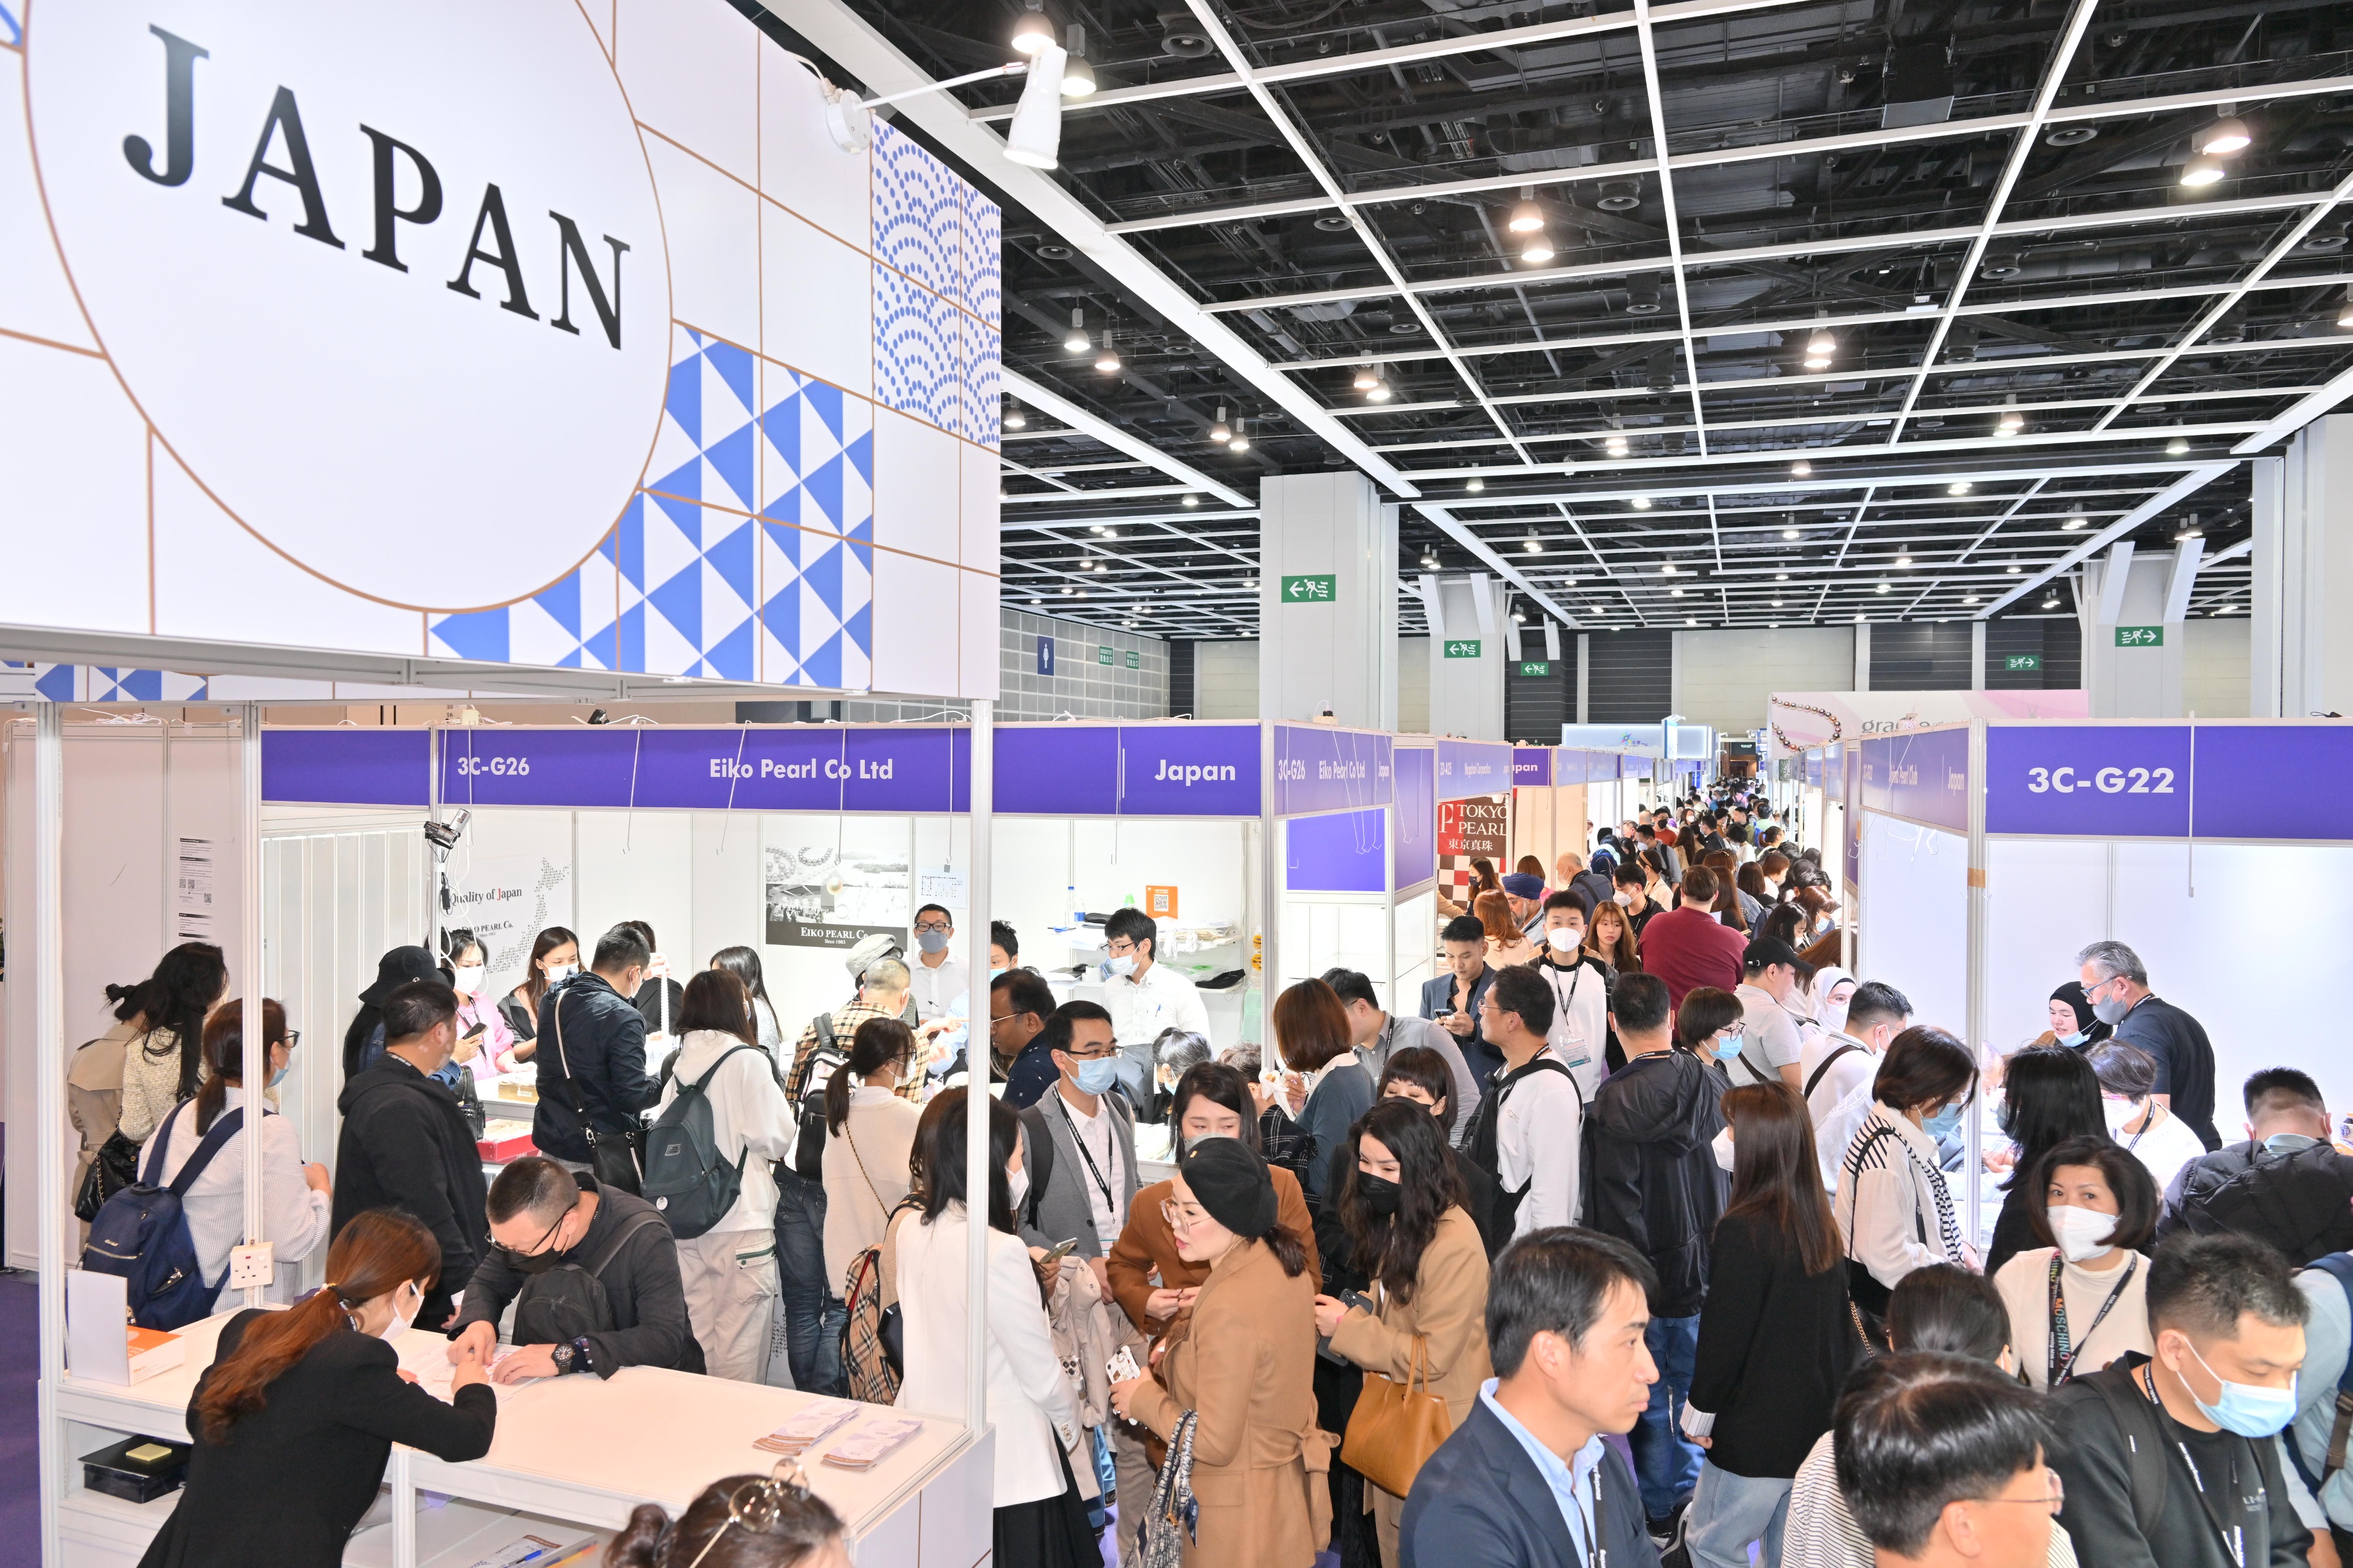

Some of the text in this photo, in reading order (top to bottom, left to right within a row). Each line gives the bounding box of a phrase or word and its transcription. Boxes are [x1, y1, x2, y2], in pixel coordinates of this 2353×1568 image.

[122, 23, 631, 351] JAPAN
[458, 757, 530, 775] 3C-G26
[710, 758, 893, 780] Eiko Pearl Co Ltd
[1155, 759, 1236, 787] Japan
[1278, 759, 1389, 781] 3C-G26 Eiko Pearl Co Ltd Japan
[1513, 762, 1538, 773] apan
[1900, 765, 1909, 785] Pearl
[1909, 765, 1918, 785] Club
[1948, 766, 1964, 796] Japan
[2028, 766, 2174, 794] 3C-G22
[1456, 804, 1507, 819] TOKYO
[1458, 821, 1507, 836] PEARL
[1448, 838, 1493, 851] 東京真珠
[450, 888, 522, 907] Quality of Japan
[481, 923, 502, 932] PEARL
[503, 921, 513, 929] Co.
[801, 927, 824, 937] EIKO
[825, 930, 855, 939] PEARL
[2054, 1298, 2071, 1361] MOSCHINO
